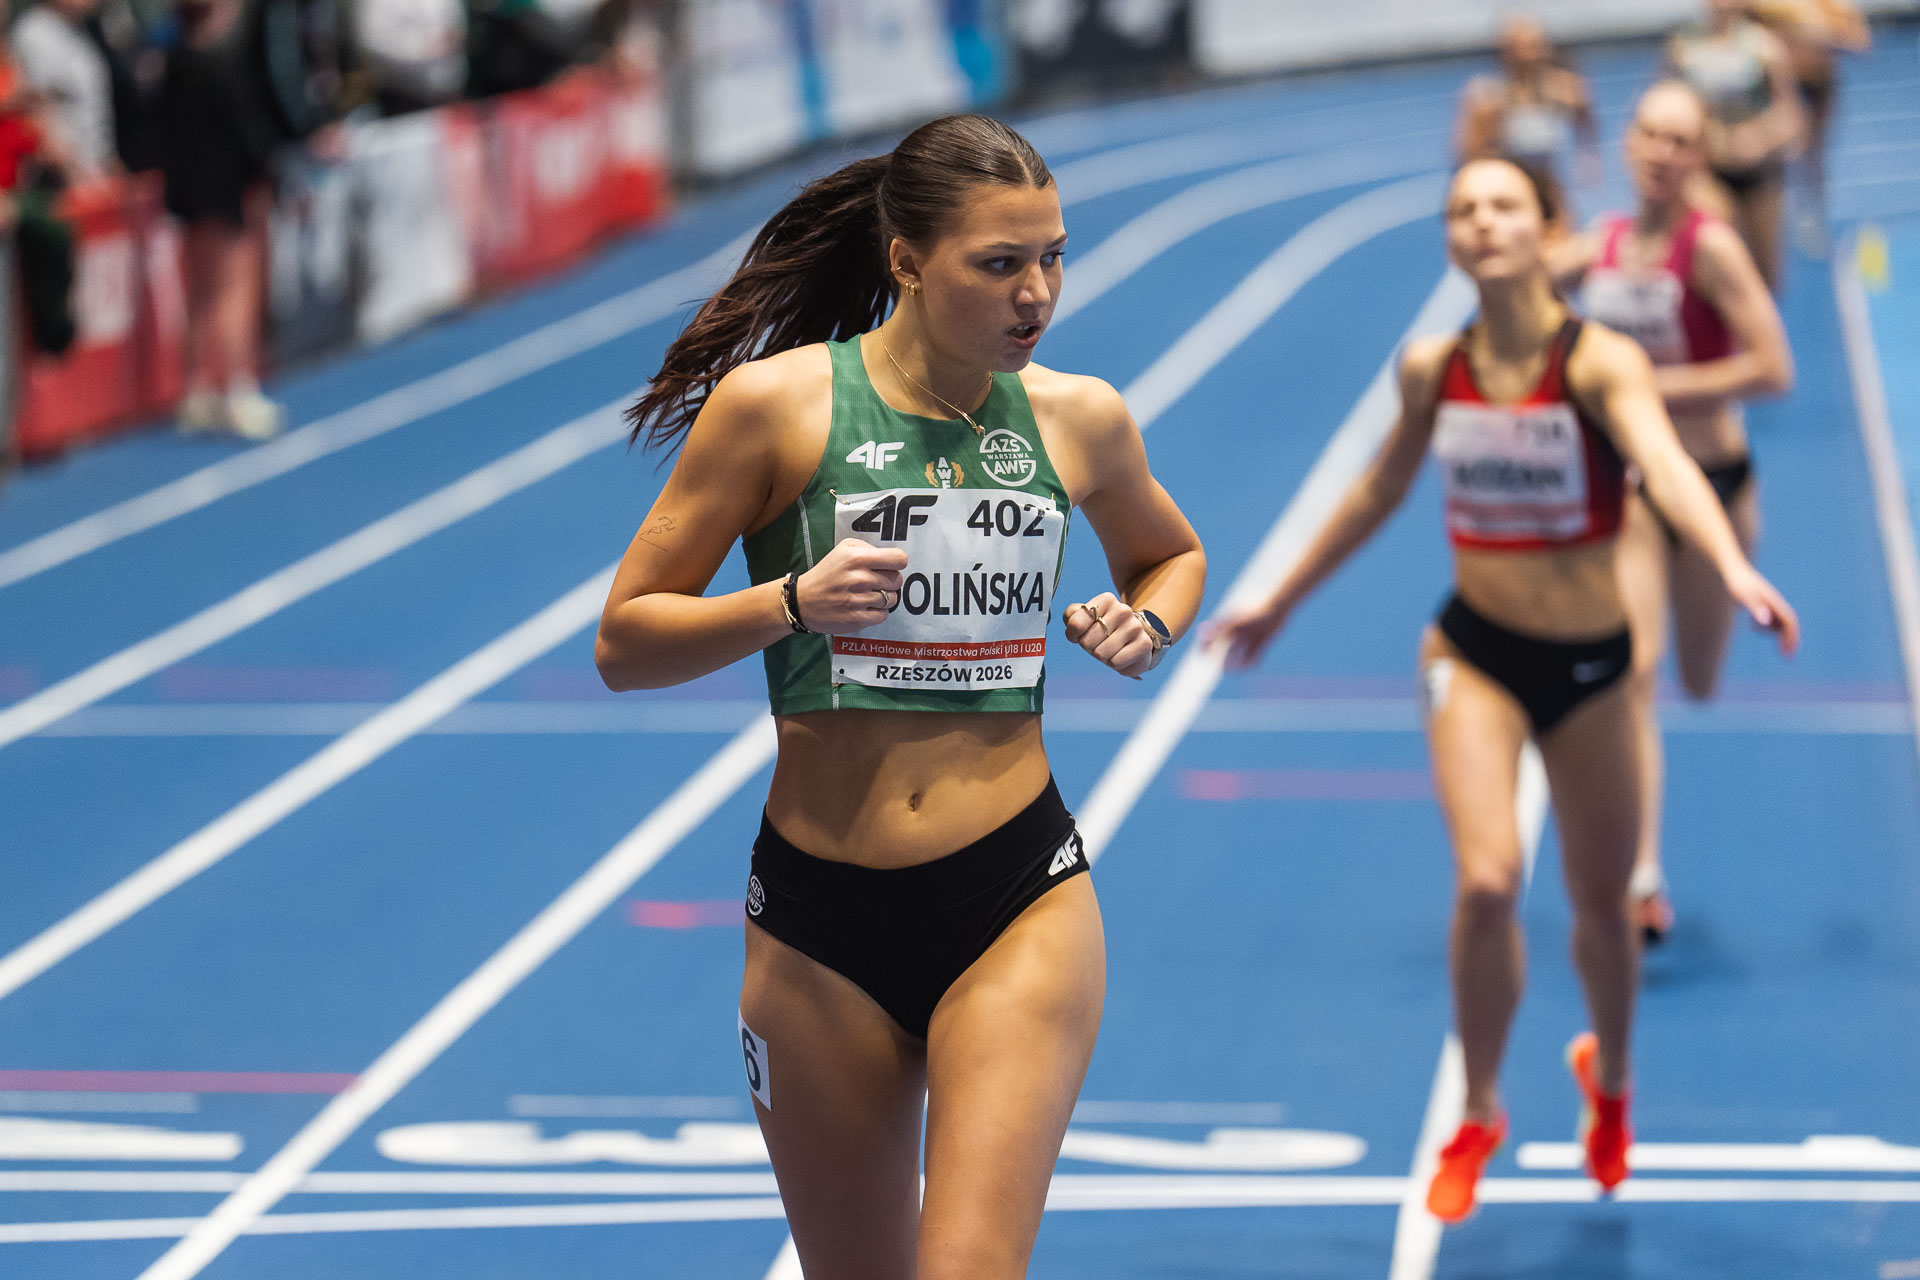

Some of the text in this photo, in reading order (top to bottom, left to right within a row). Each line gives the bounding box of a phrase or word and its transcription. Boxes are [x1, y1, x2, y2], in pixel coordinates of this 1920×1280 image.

[846, 440, 905, 471] 4F
[986, 452, 1030, 460] WARSZAWA
[990, 438, 1021, 453] AZS
[994, 460, 1029, 475] AWF
[851, 494, 939, 541] 4F
[966, 499, 1045, 537] 402
[841, 641, 867, 652] PZLA
[870, 643, 911, 655] Halowe
[914, 646, 978, 658] Mistrzostwa
[979, 644, 1003, 657] Polski
[1004, 644, 1019, 655] U18
[1024, 642, 1042, 653] U20
[876, 663, 1013, 683] RZESZÓW 2026
[1048, 831, 1079, 876] 4F
[742, 1027, 761, 1092] 6
